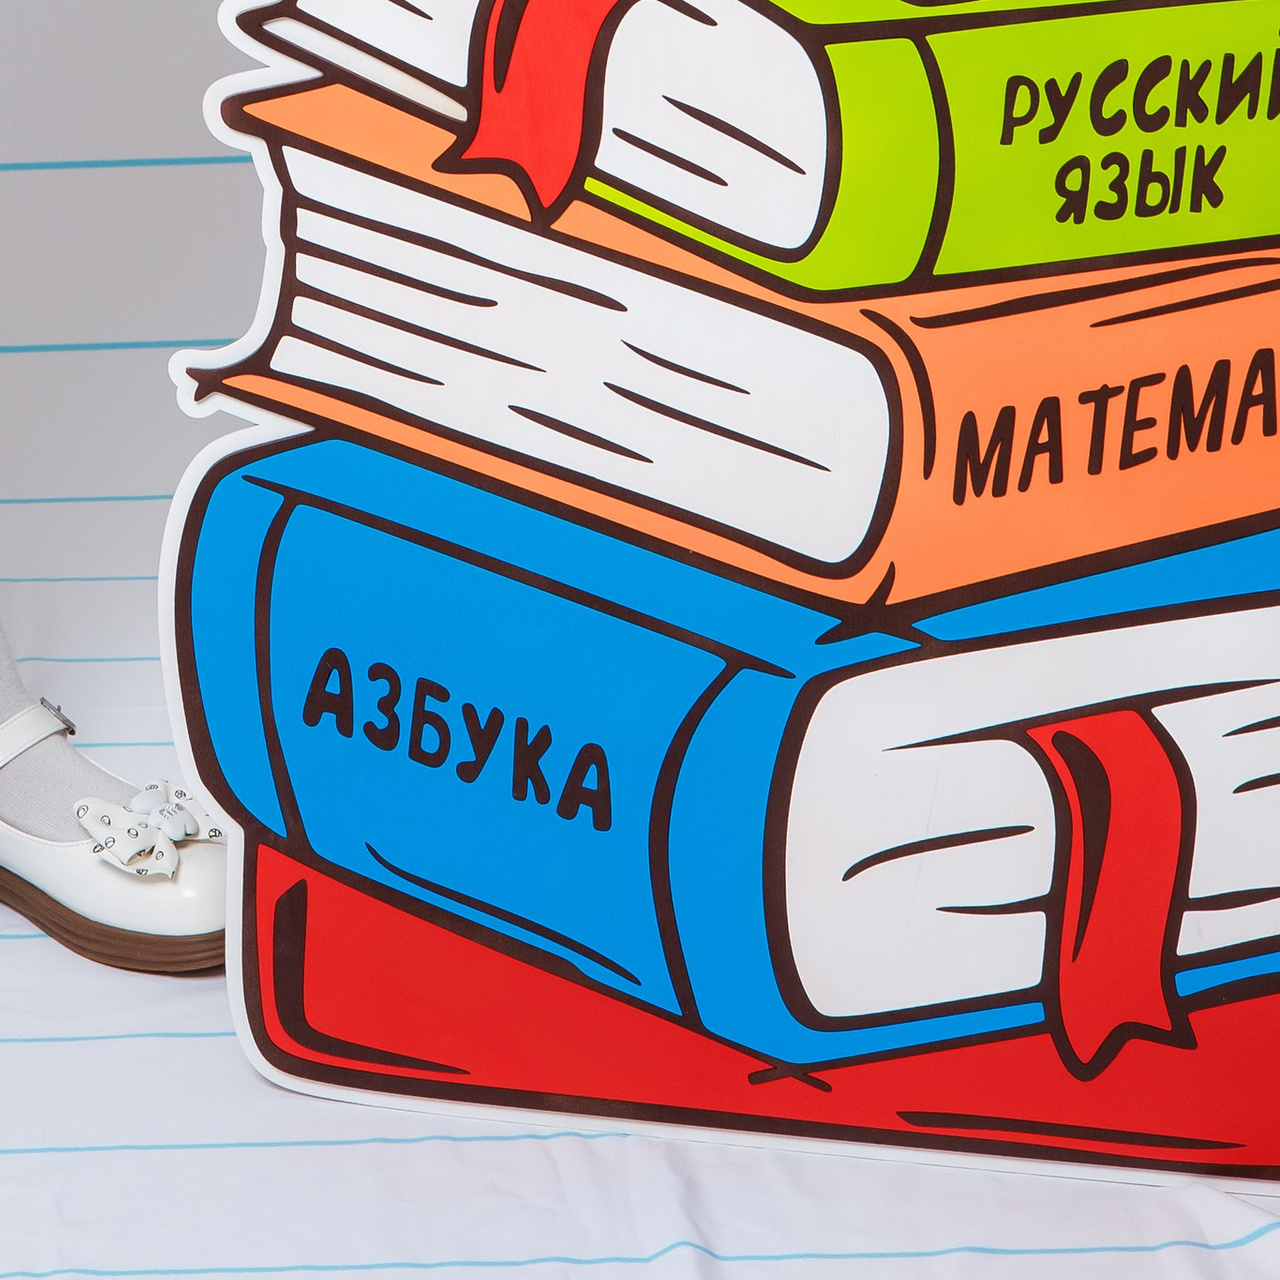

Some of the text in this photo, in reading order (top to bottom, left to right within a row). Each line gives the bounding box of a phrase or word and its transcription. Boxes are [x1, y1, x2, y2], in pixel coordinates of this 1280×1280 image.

[999, 28, 1280, 146] РУССКИ
[1054, 144, 1227, 225] ЯЗЫК
[952, 347, 1278, 506] МАТЕМА
[302, 647, 612, 832] АЗБУКА
